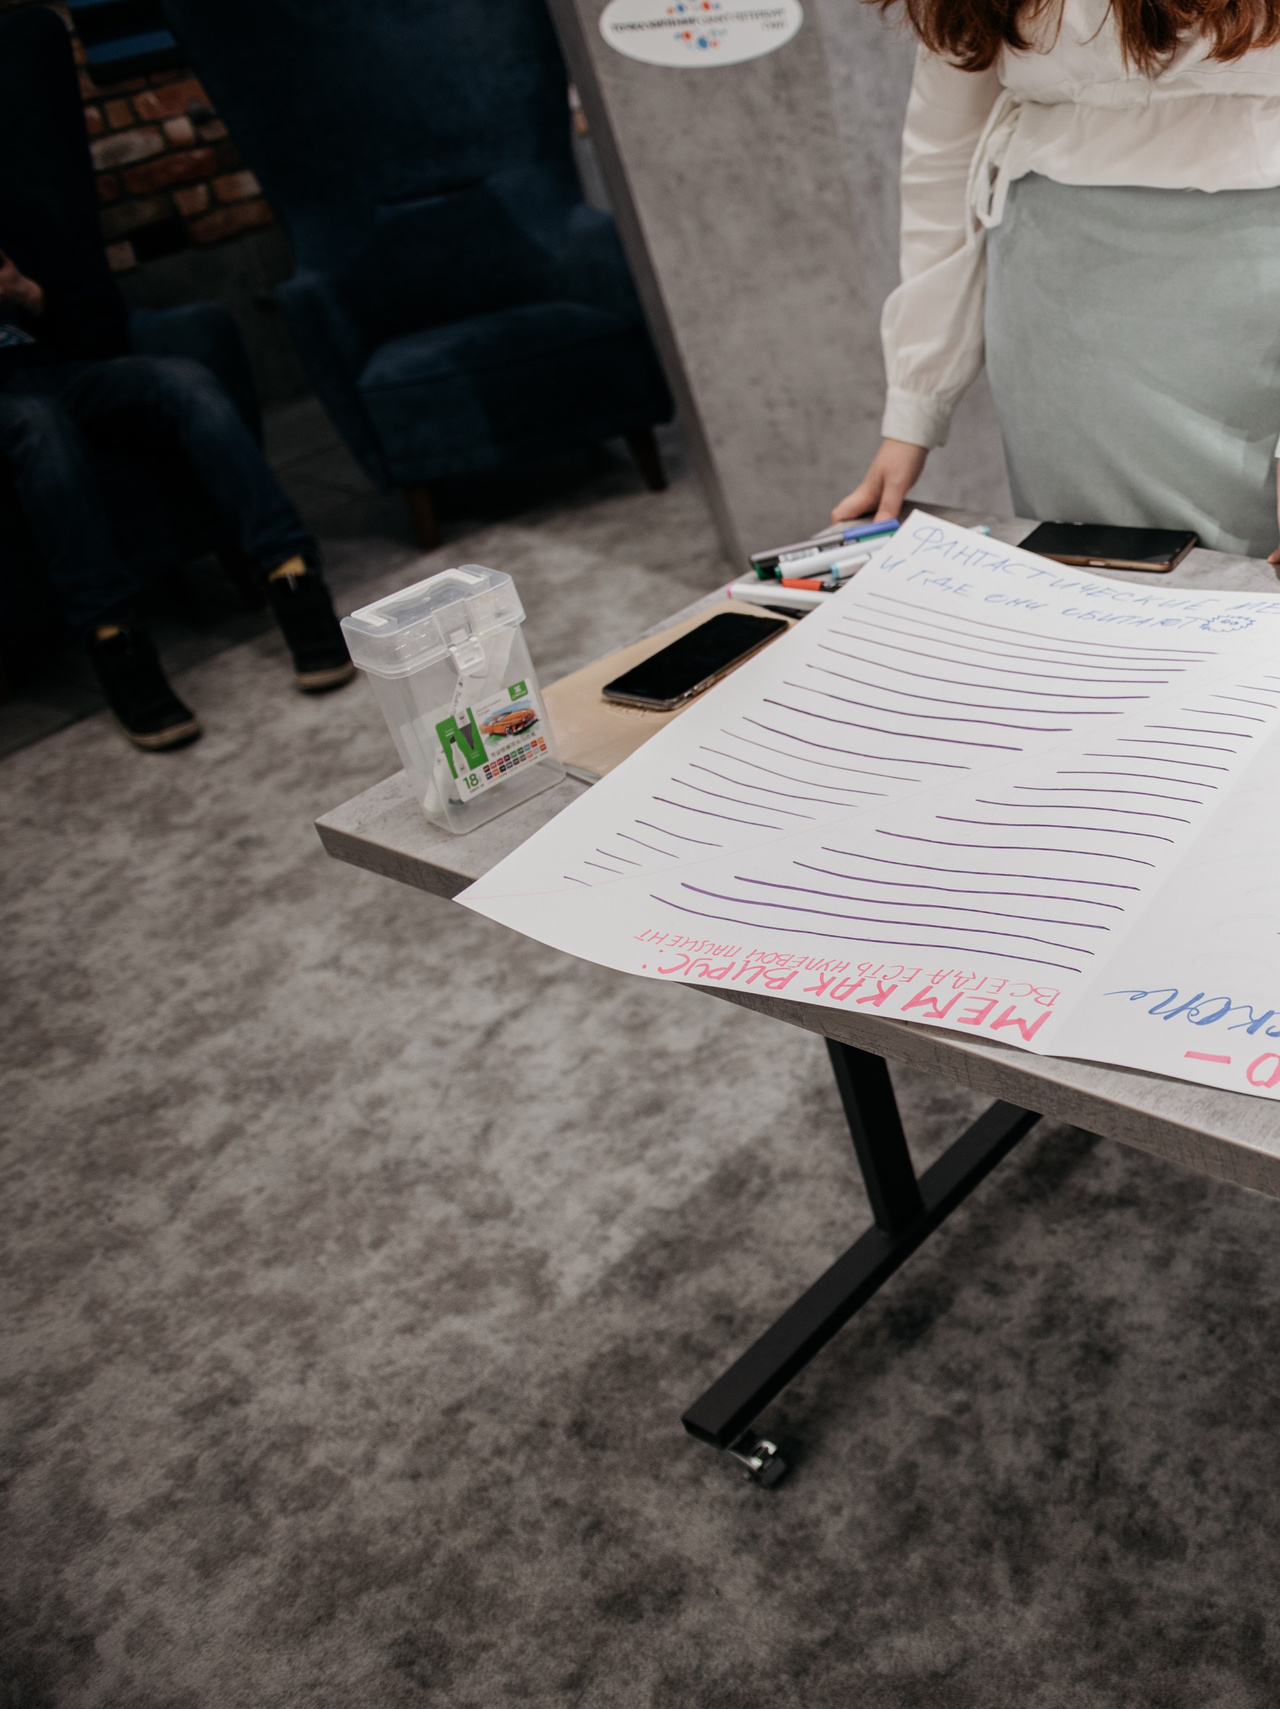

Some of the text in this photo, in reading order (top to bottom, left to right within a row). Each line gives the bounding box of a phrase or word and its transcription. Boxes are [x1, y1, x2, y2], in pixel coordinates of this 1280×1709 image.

[463, 773, 479, 790] 18
[634, 928, 742, 958] ПАЦИЕНТ
[853, 962, 923, 984] ЕСТЬ
[931, 968, 1061, 1008] ВСЕГДА
[803, 973, 898, 1008] КАК
[901, 984, 1053, 1042] МЕМ
